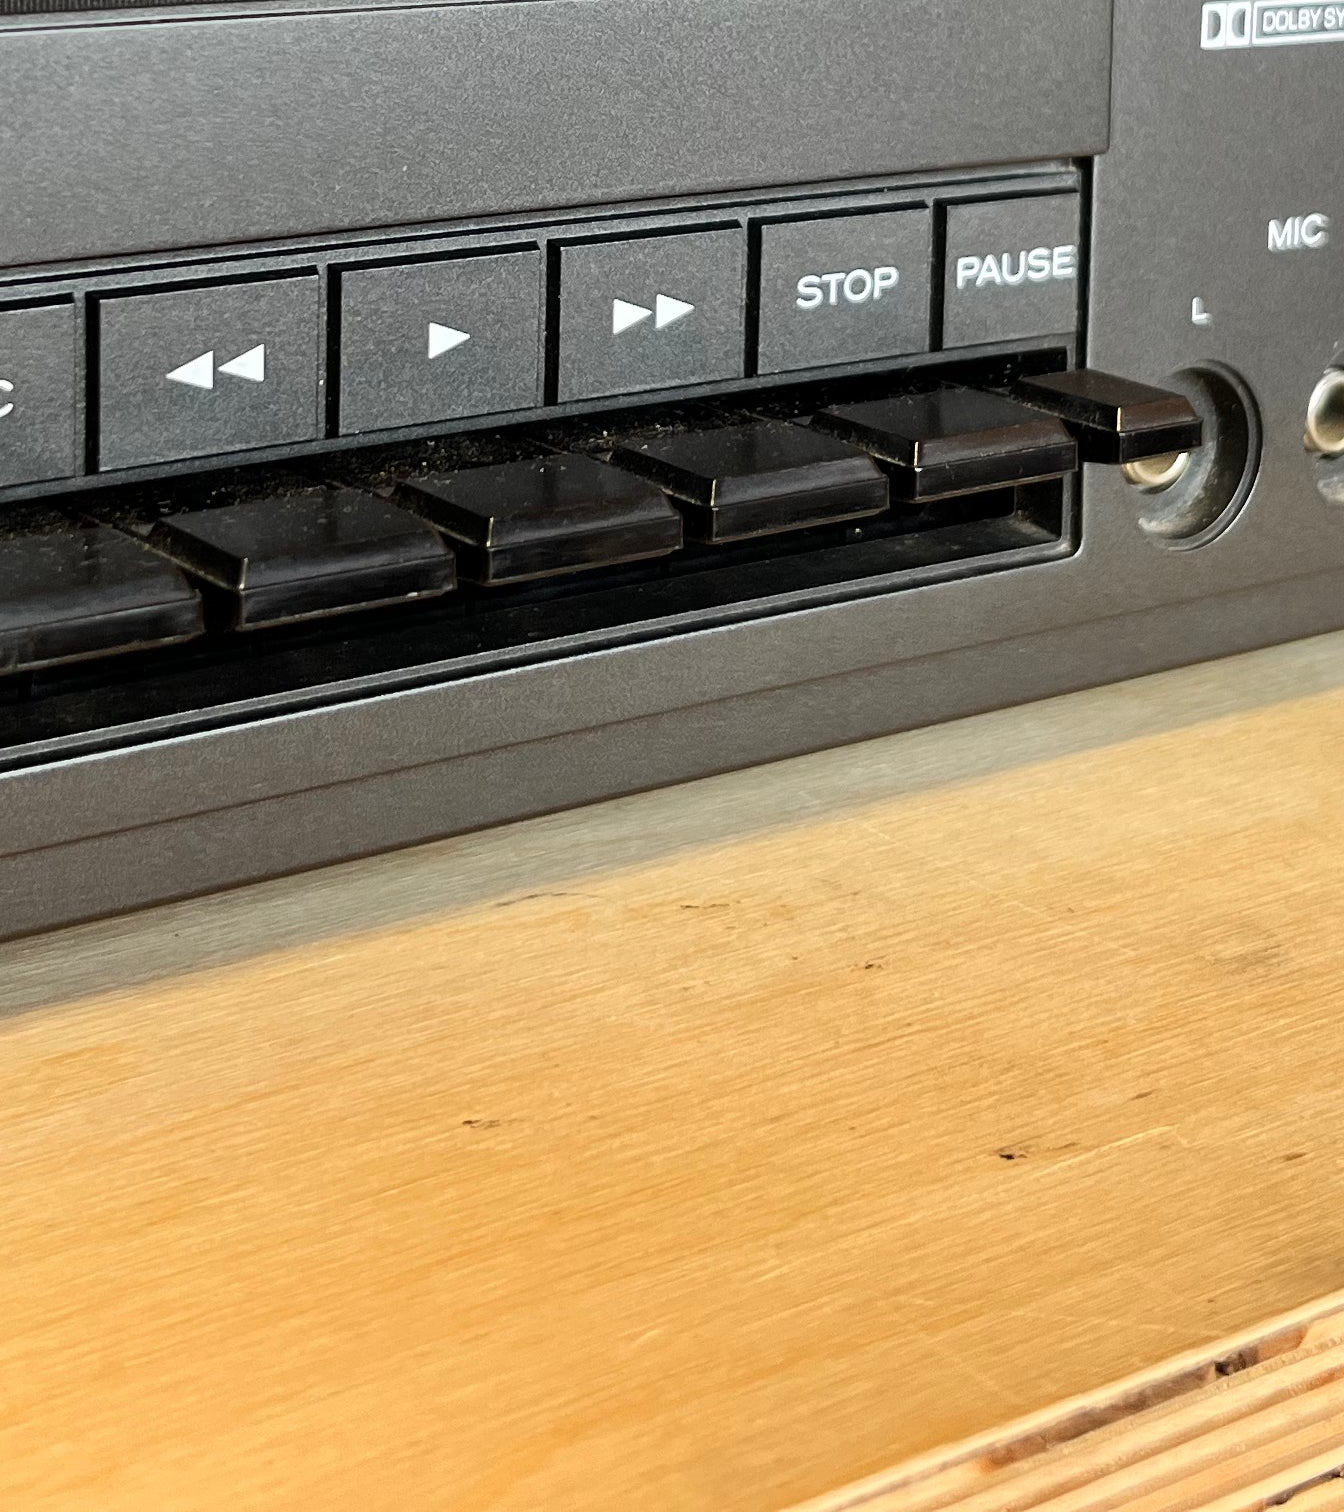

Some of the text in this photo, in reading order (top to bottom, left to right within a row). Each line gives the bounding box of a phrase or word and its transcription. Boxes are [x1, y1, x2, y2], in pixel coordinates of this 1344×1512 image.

[1262, 4, 1324, 35] DOLBY
[1267, 212, 1331, 252] MIC
[956, 244, 1078, 289] PAUSE
[796, 266, 900, 310] STOP
[1191, 296, 1213, 325] L
